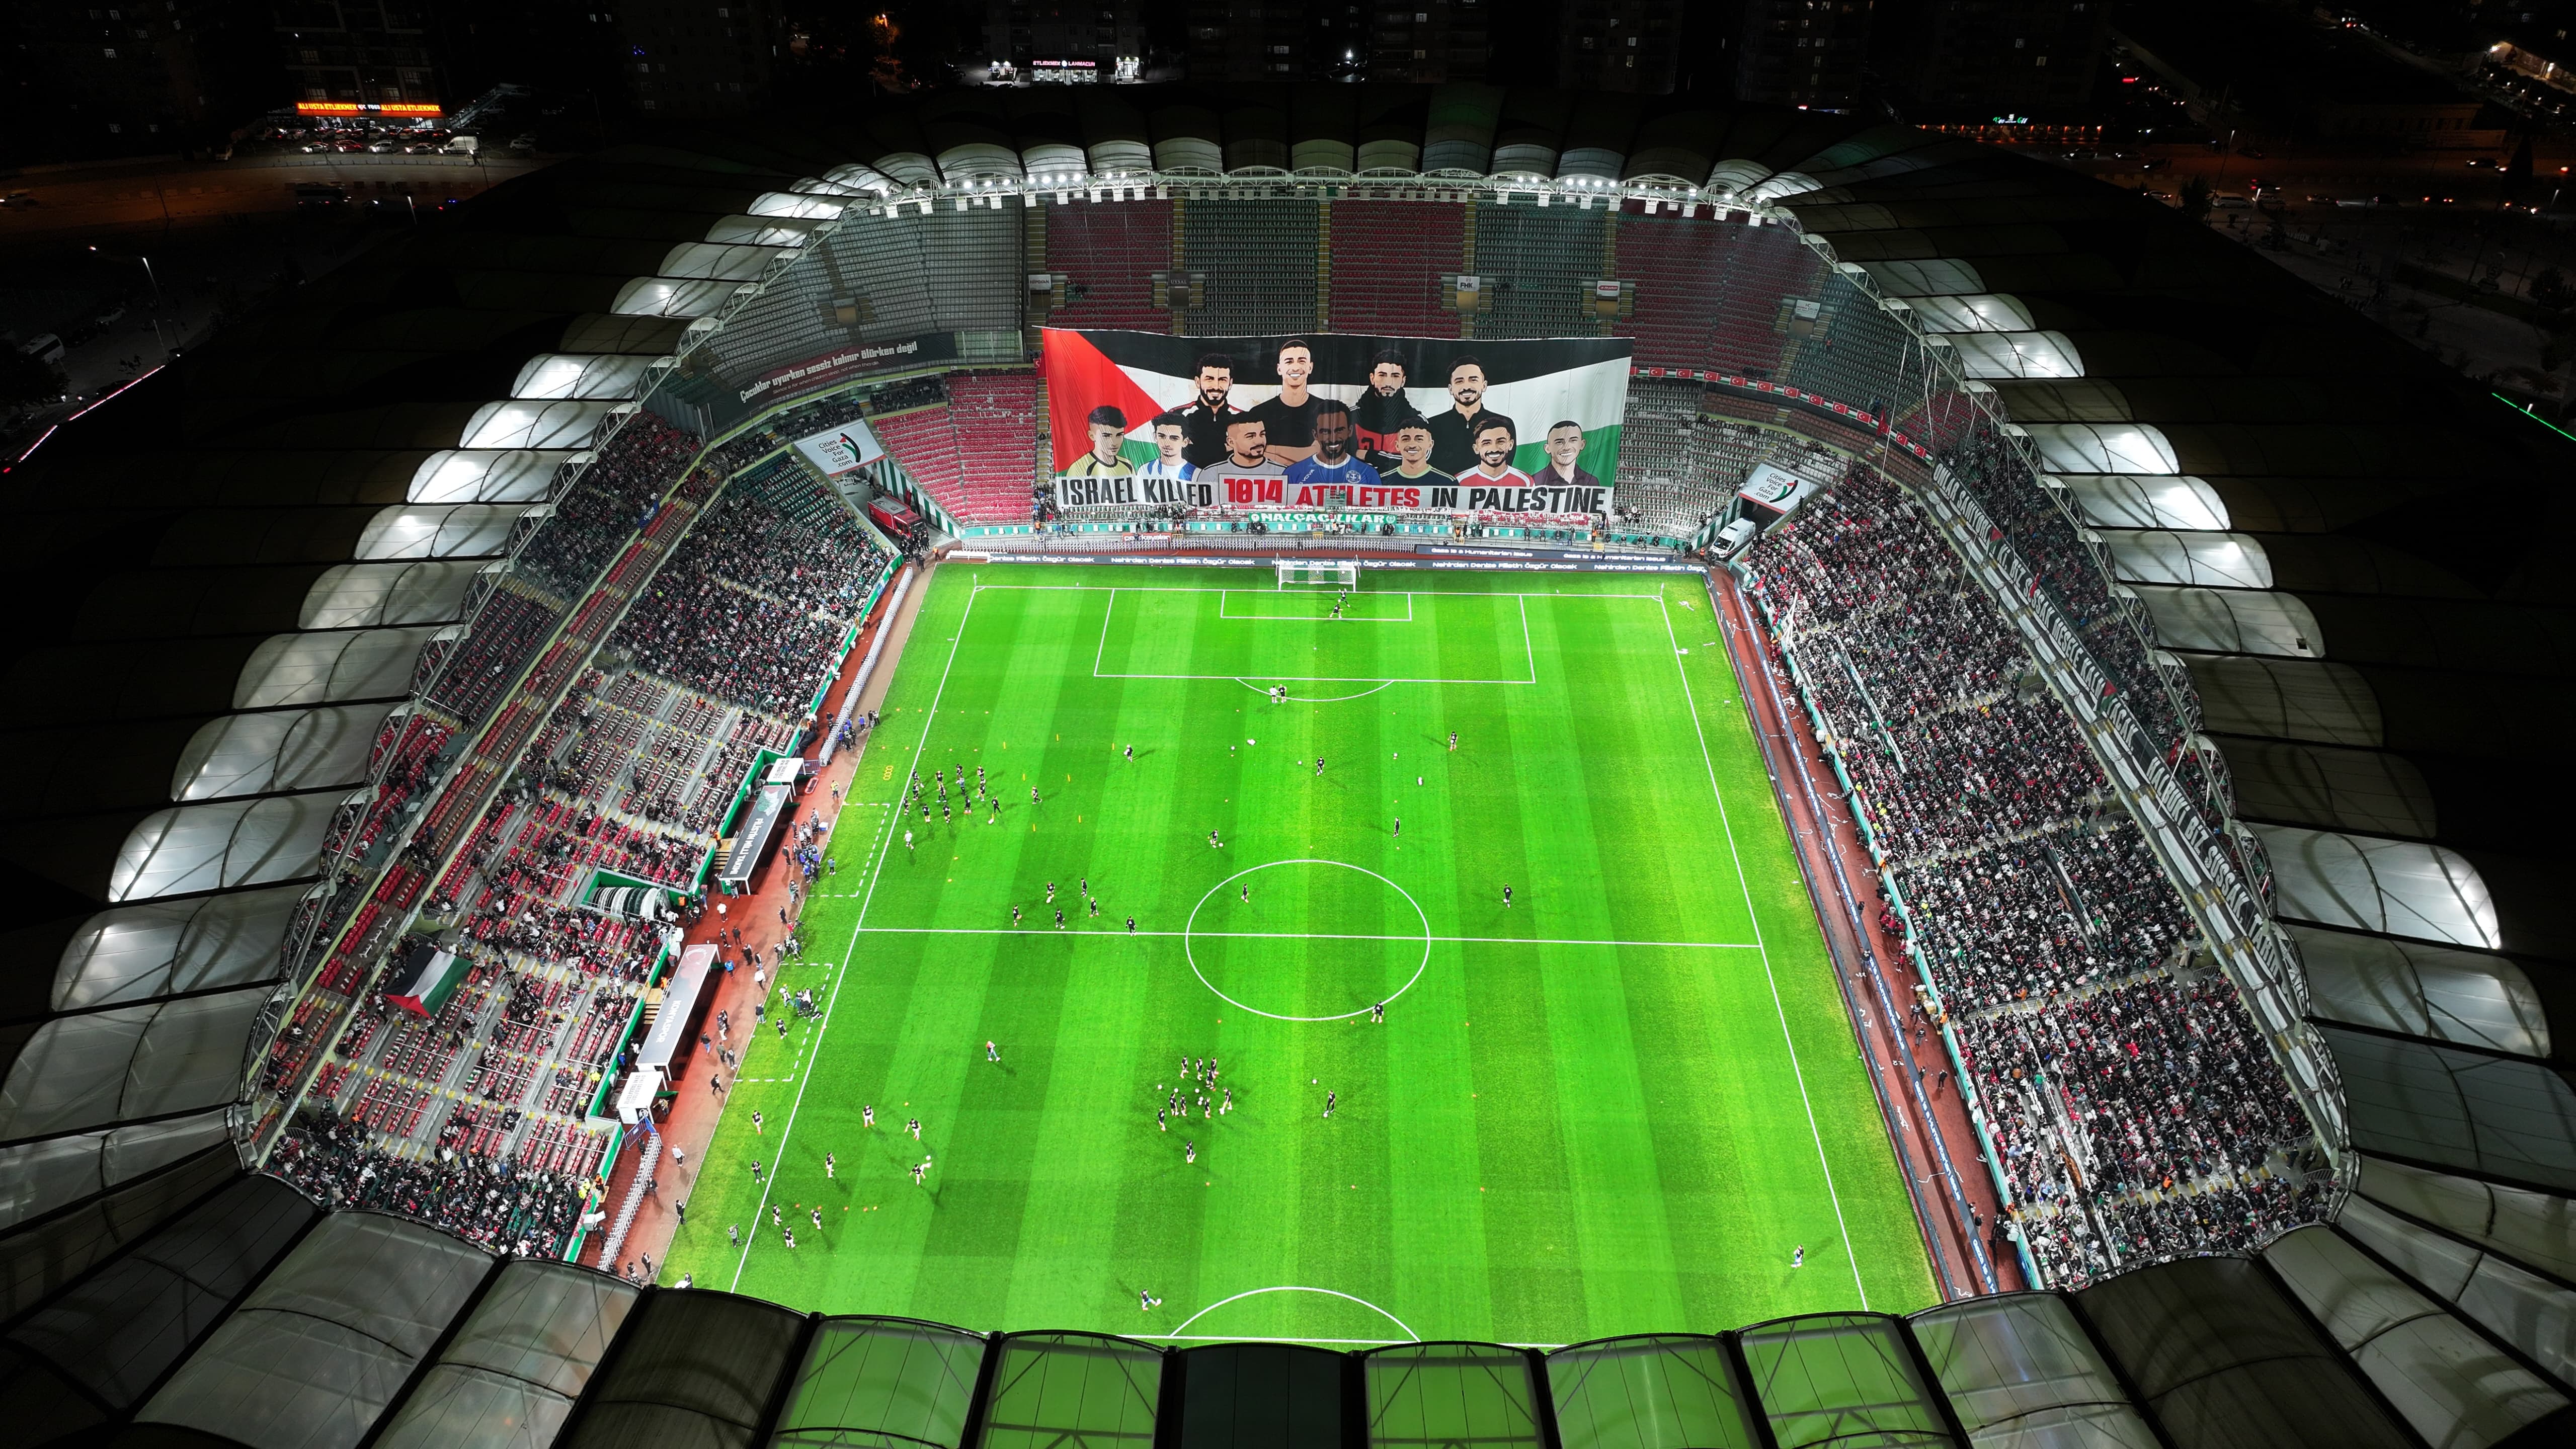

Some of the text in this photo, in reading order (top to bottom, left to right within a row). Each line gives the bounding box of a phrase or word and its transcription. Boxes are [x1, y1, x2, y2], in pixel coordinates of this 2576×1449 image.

[740, 380, 771, 404] Çocuklar
[772, 369, 806, 386] uyurken
[807, 360, 832, 375] sessiz
[861, 347, 895, 360] ölürken
[897, 341, 918, 354] değil
[819, 440, 837, 448] Cities
[822, 445, 841, 453] Voice
[1061, 477, 1138, 506] ISRAEL
[1143, 479, 1212, 507] KILLED
[1224, 478, 1283, 504] 1014
[1431, 488, 1459, 508] IN
[1469, 487, 1606, 514] PALESTINE
[1759, 487, 1774, 495] Gaza
[1766, 477, 1782, 487] Voice
[1769, 473, 1787, 482] Cities
[1934, 463, 1960, 501] ONLAR
[2052, 617, 2083, 668] MESELE
[747, 818, 764, 840] FİLİSTİN
[2185, 816, 2209, 855] BİZ
[1825, 837, 1834, 853] Gaza
[1834, 863, 1854, 905] Humanitarian
[656, 1000, 682, 1043] KONYASPOR
[1876, 980, 1898, 1028] Humanitarian
[1913, 1080, 1925, 1102] Gaza
[1927, 1118, 1952, 1176] Humanitarian
[1972, 1238, 1984, 1264] Gaza
